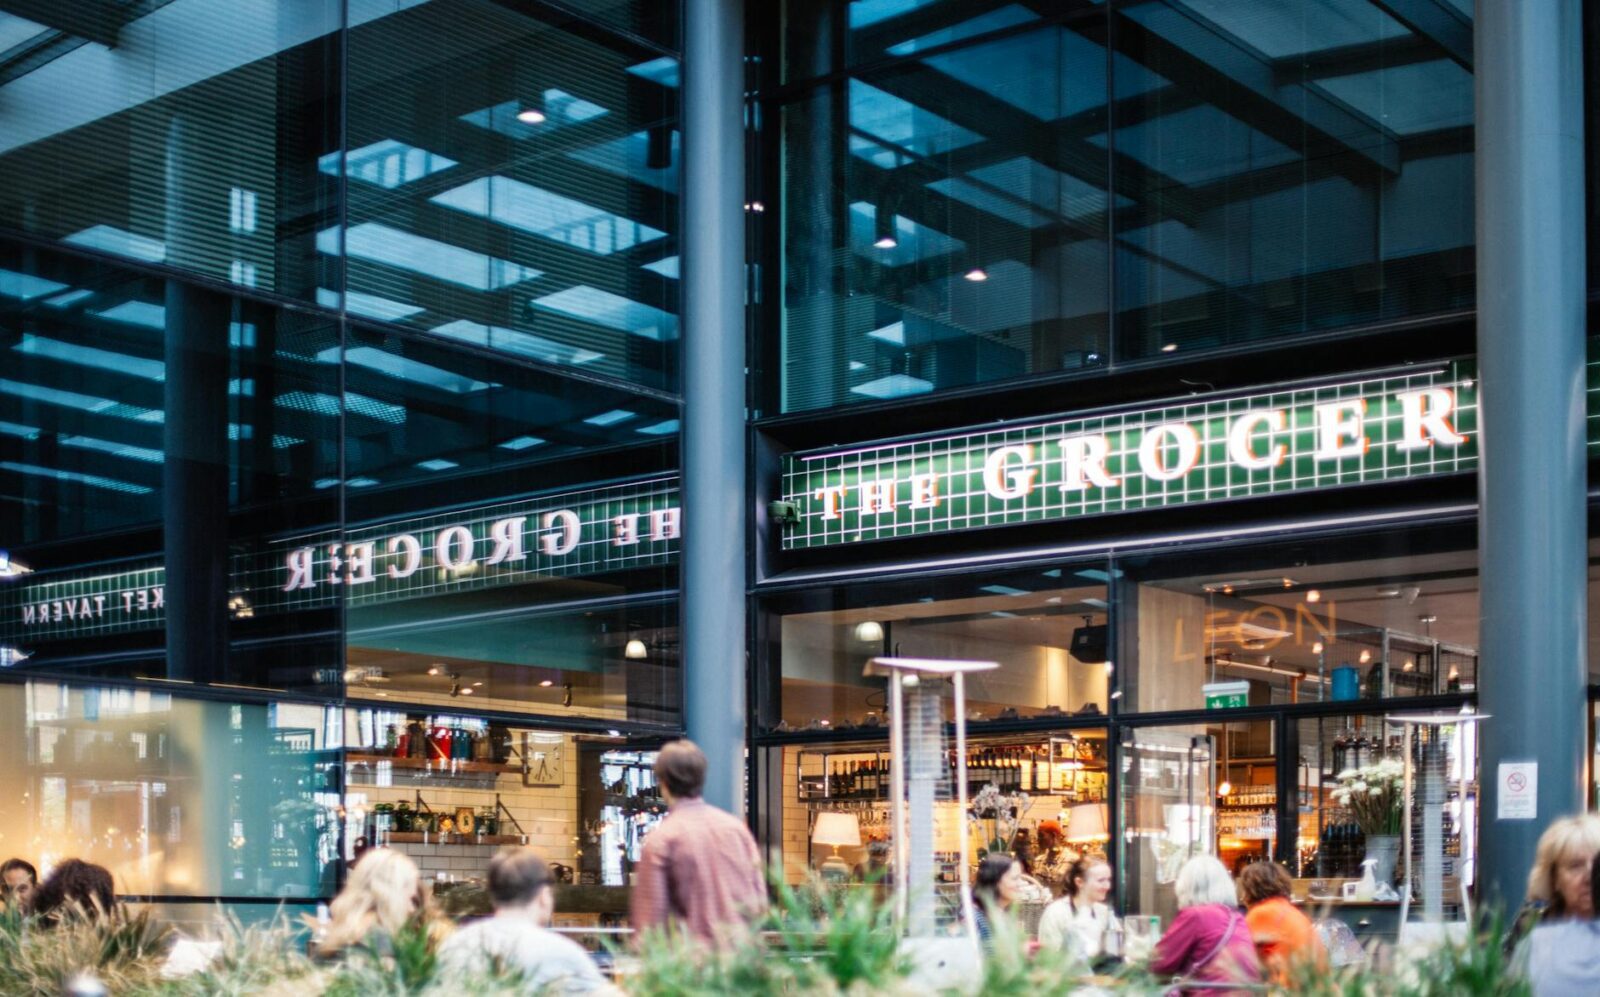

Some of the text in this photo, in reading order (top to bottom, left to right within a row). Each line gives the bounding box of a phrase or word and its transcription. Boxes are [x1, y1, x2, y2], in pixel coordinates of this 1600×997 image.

[815, 387, 1469, 520] THE GROCER
[1173, 600, 1336, 663] LEON
